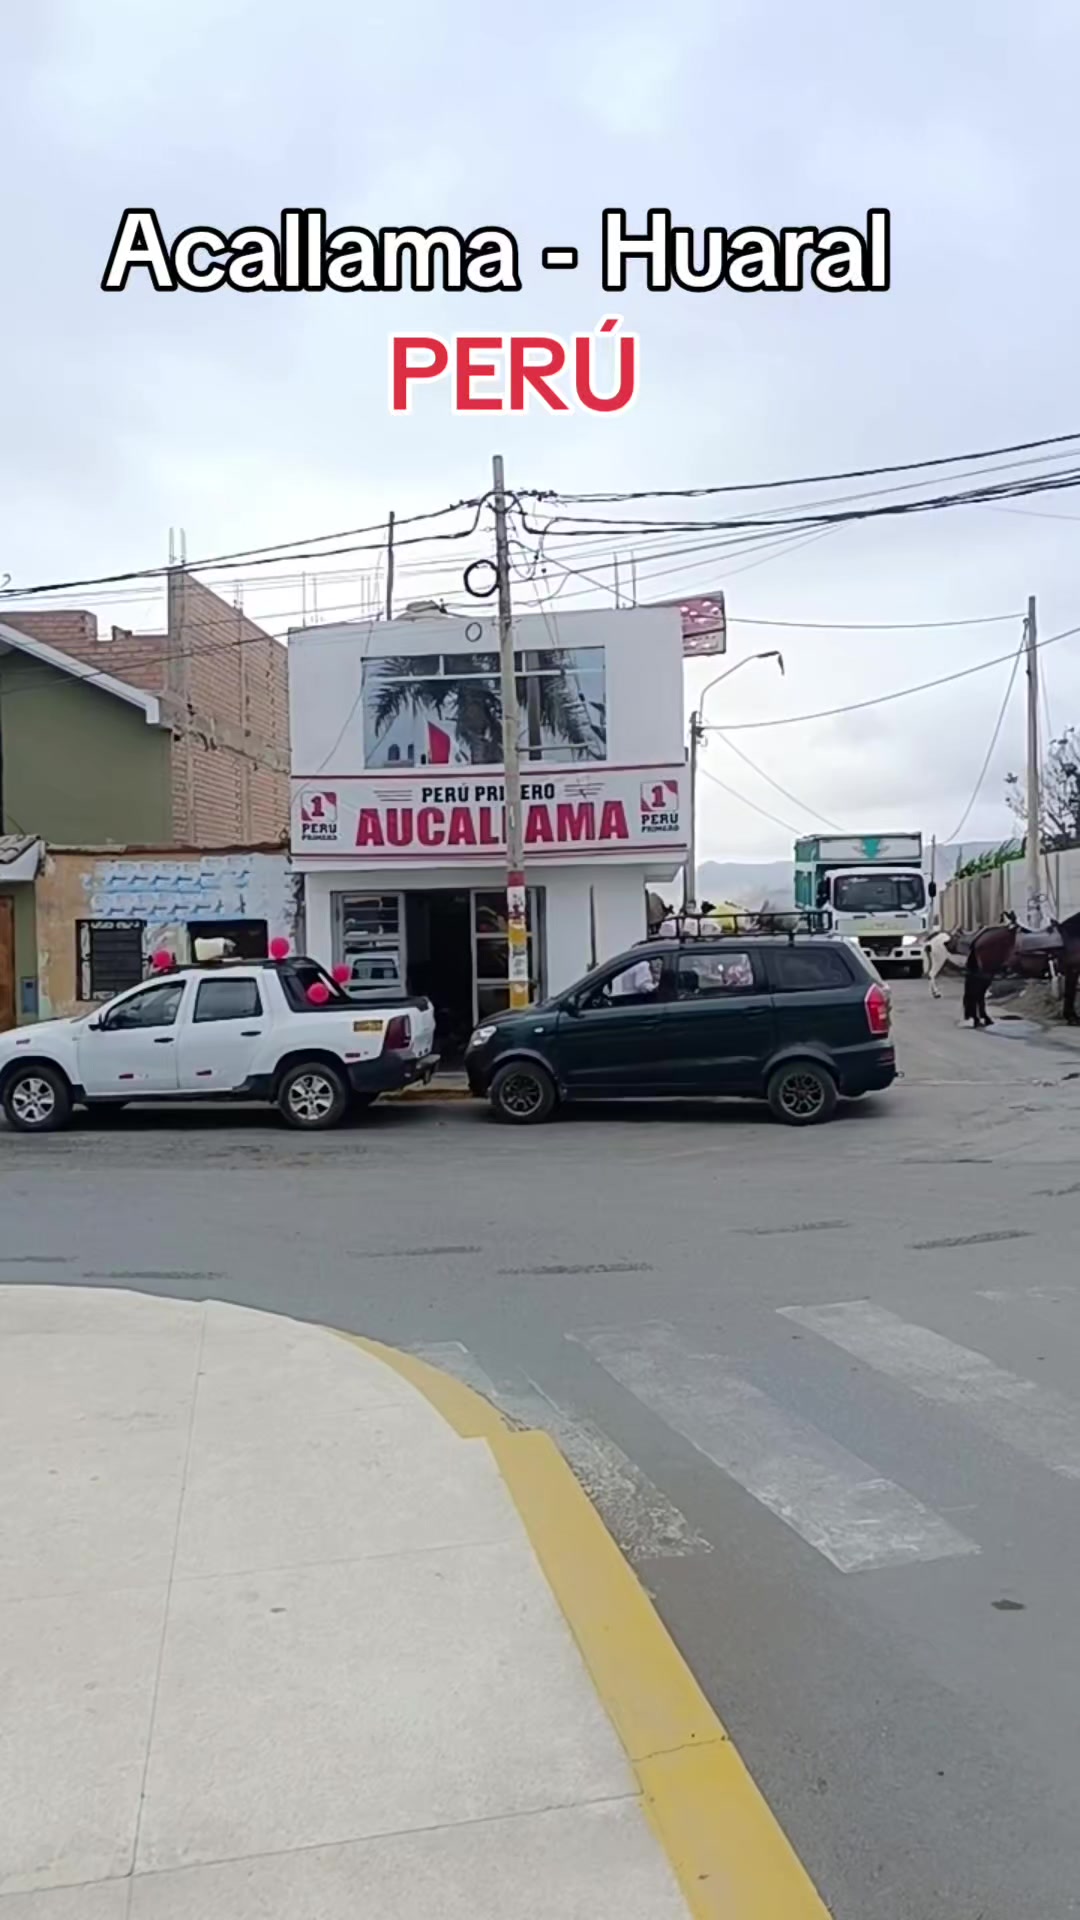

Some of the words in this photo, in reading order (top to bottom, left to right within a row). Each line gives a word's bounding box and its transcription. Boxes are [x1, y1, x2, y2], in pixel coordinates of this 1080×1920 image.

[422, 783, 469, 802] PERÚ
[475, 783, 556, 802] PRIERO
[651, 785, 666, 808] 1
[311, 795, 325, 817] 1
[355, 800, 629, 847] AUCALAMA
